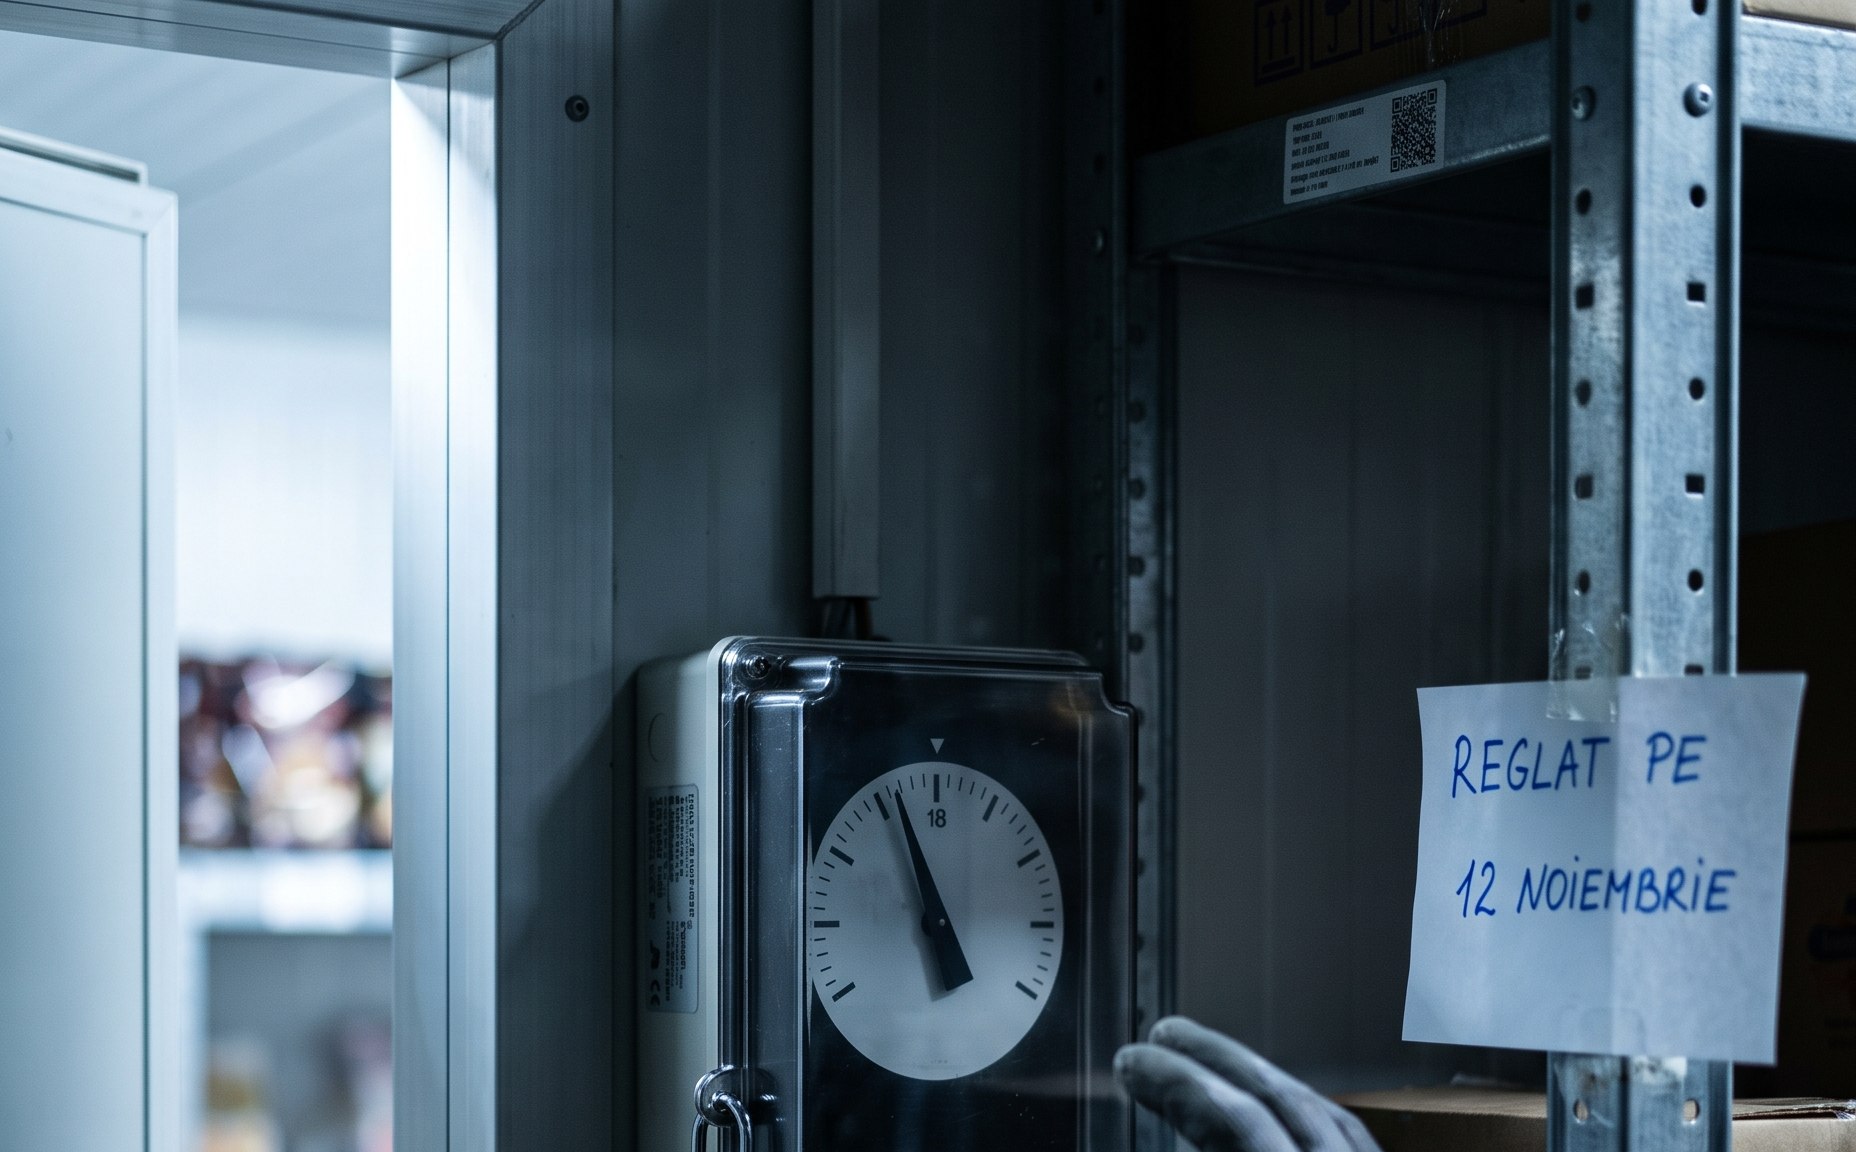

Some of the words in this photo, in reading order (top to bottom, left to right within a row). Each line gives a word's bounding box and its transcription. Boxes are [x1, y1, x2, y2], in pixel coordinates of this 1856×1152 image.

[1452, 734, 1611, 798] REGLAT
[1645, 731, 1707, 785] PE
[927, 808, 947, 828] 18
[1456, 859, 1496, 918] 12
